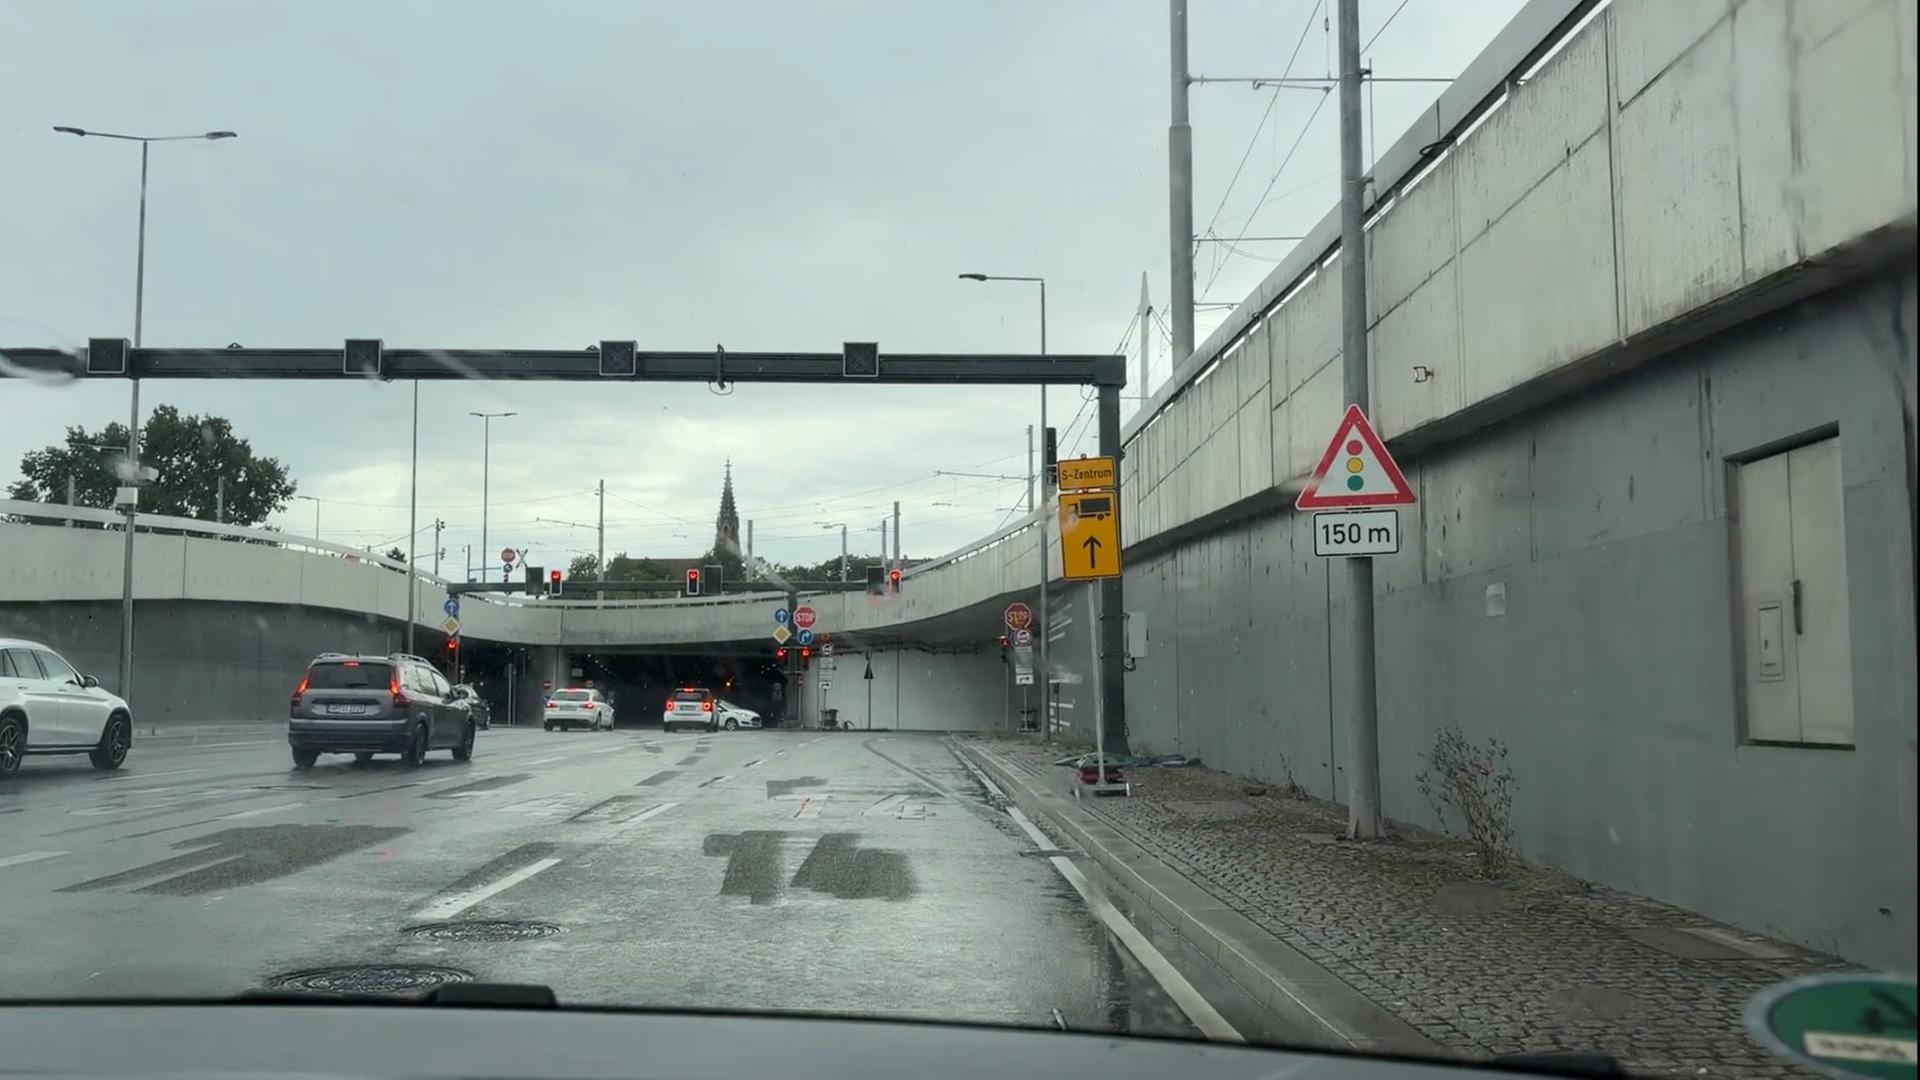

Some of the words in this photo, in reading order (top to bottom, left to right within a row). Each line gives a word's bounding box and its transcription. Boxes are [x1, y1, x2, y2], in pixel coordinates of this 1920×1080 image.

[1061, 468, 1112, 481] S-Zentrum
[1322, 523, 1361, 545] 150
[1368, 527, 1390, 543] m
[796, 612, 814, 623] STOP
